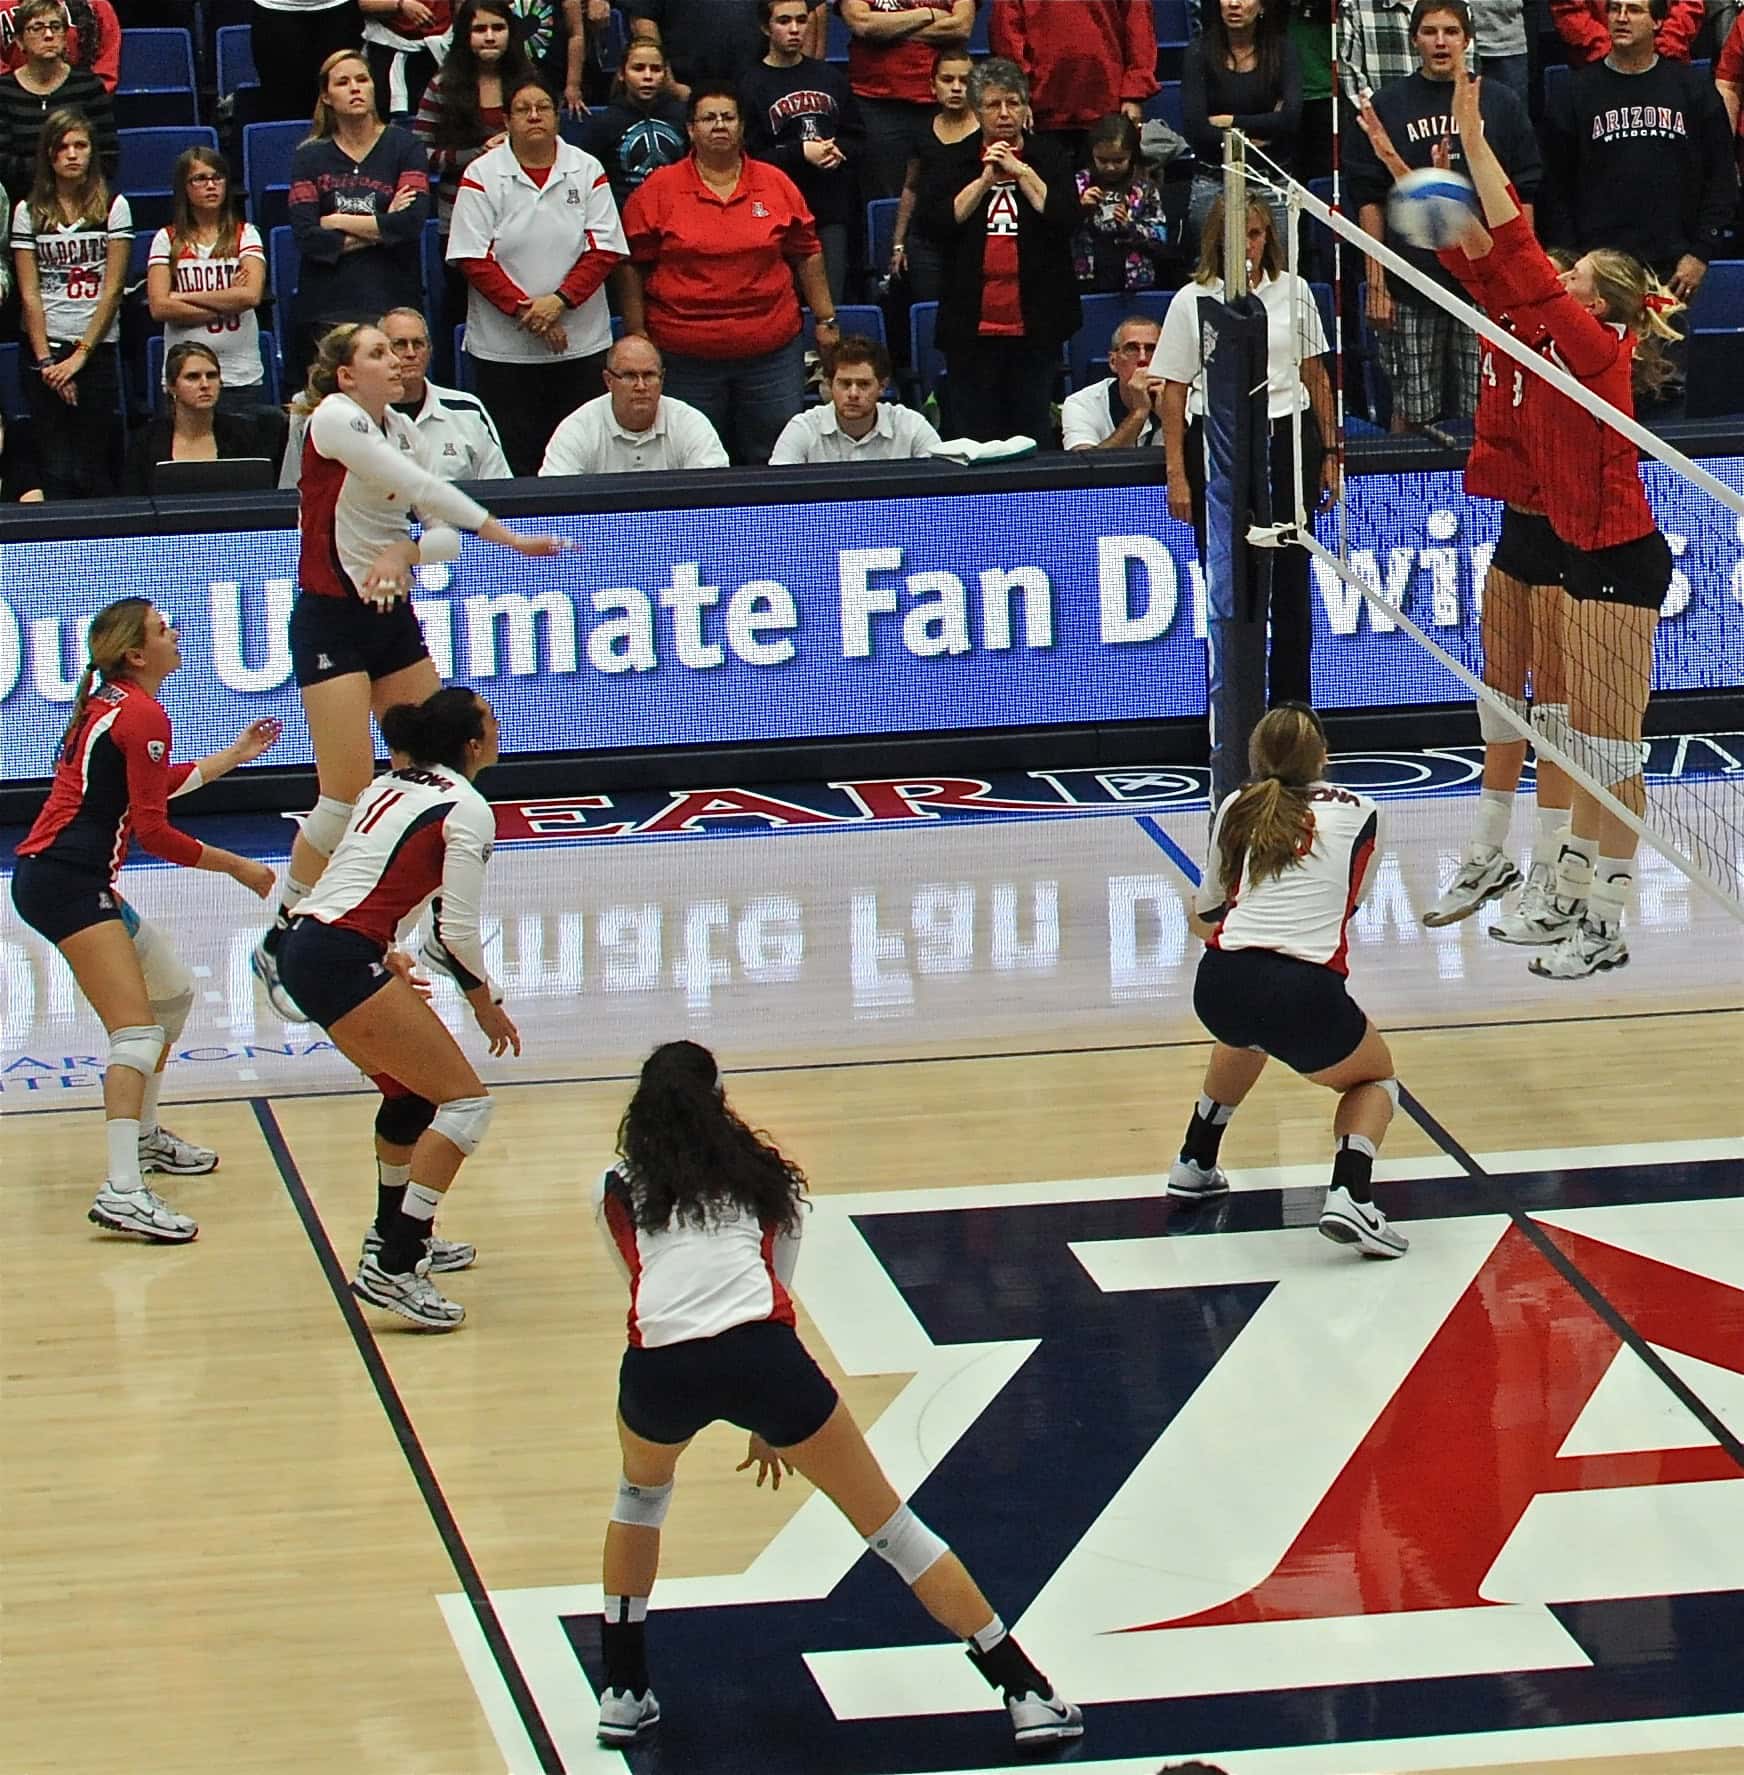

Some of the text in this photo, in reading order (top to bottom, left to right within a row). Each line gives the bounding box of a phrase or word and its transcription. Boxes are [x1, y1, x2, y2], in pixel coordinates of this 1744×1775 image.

[1406, 115, 1485, 142] ARIZO
[1592, 106, 1686, 140] ARIZONA
[1603, 129, 1676, 143] WILDCATS
[838, 547, 1054, 658] Fan
[353, 788, 405, 835] 11
